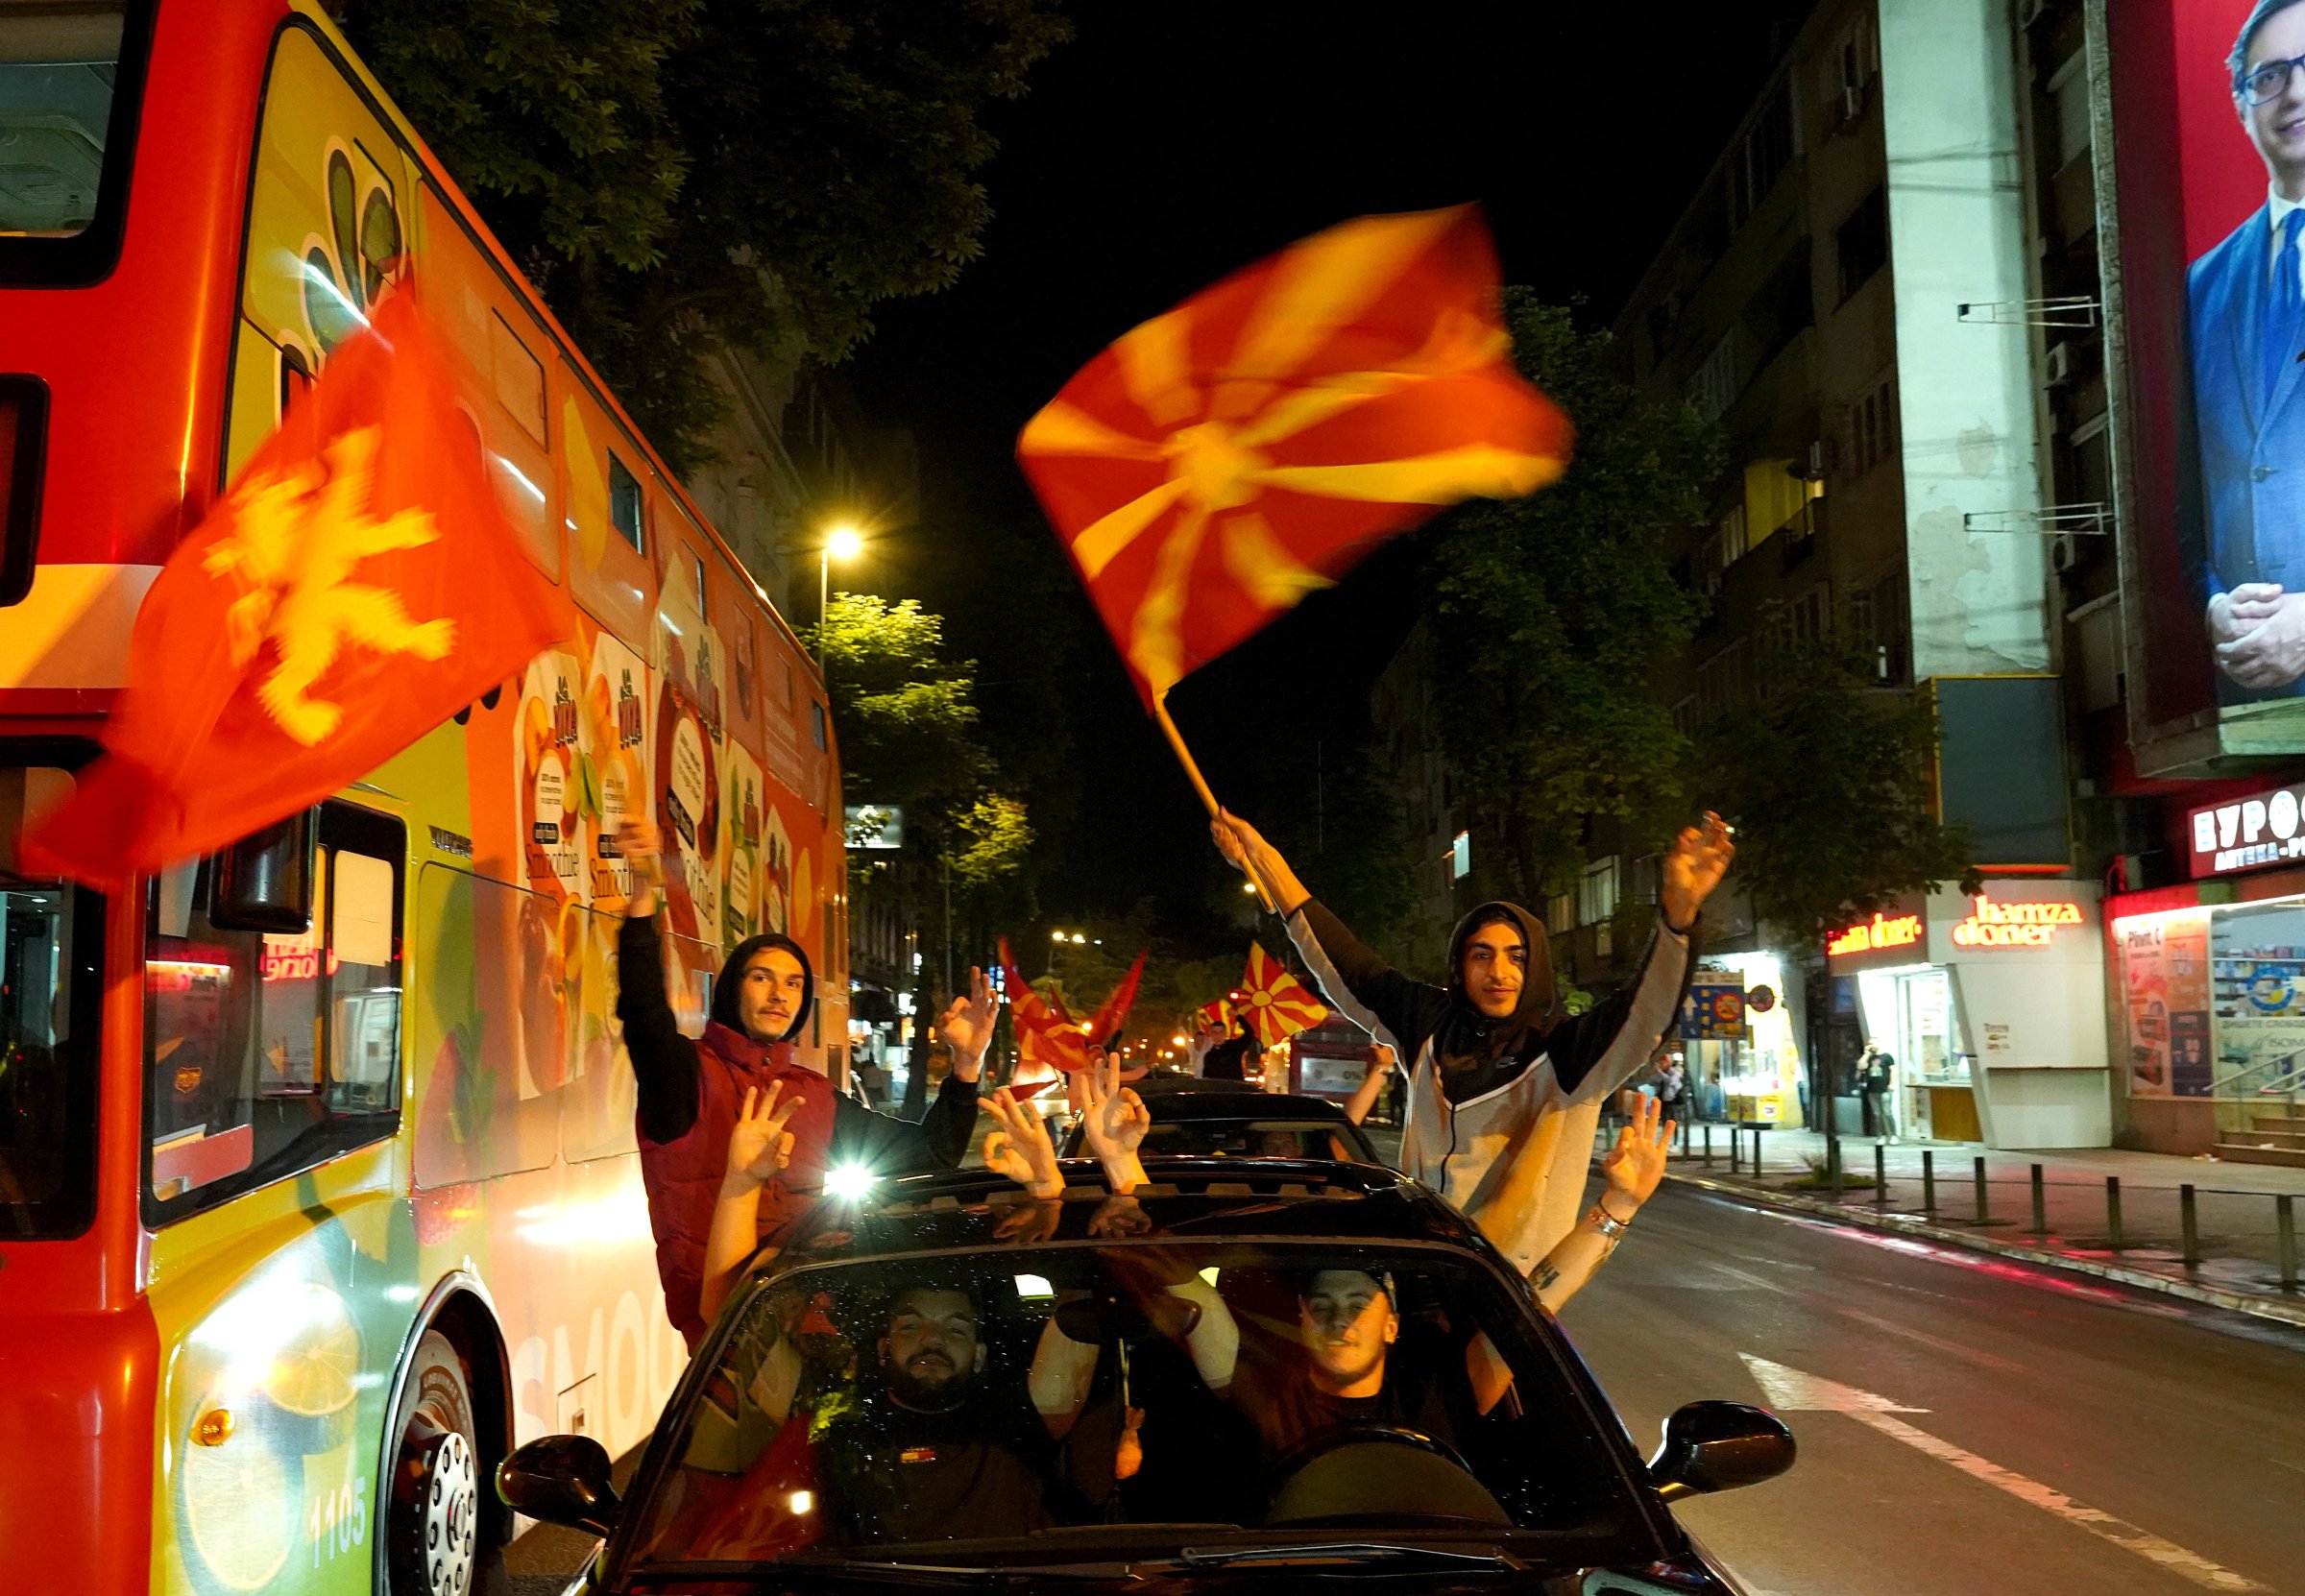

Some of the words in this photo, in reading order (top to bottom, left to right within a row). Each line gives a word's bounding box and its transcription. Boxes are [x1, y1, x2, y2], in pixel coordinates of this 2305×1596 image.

[2194, 789, 2305, 853] ЕУРО
[1953, 915, 2056, 946] doner
[1975, 894, 2083, 924] hamza
[309, 1476, 366, 1569] 1105
